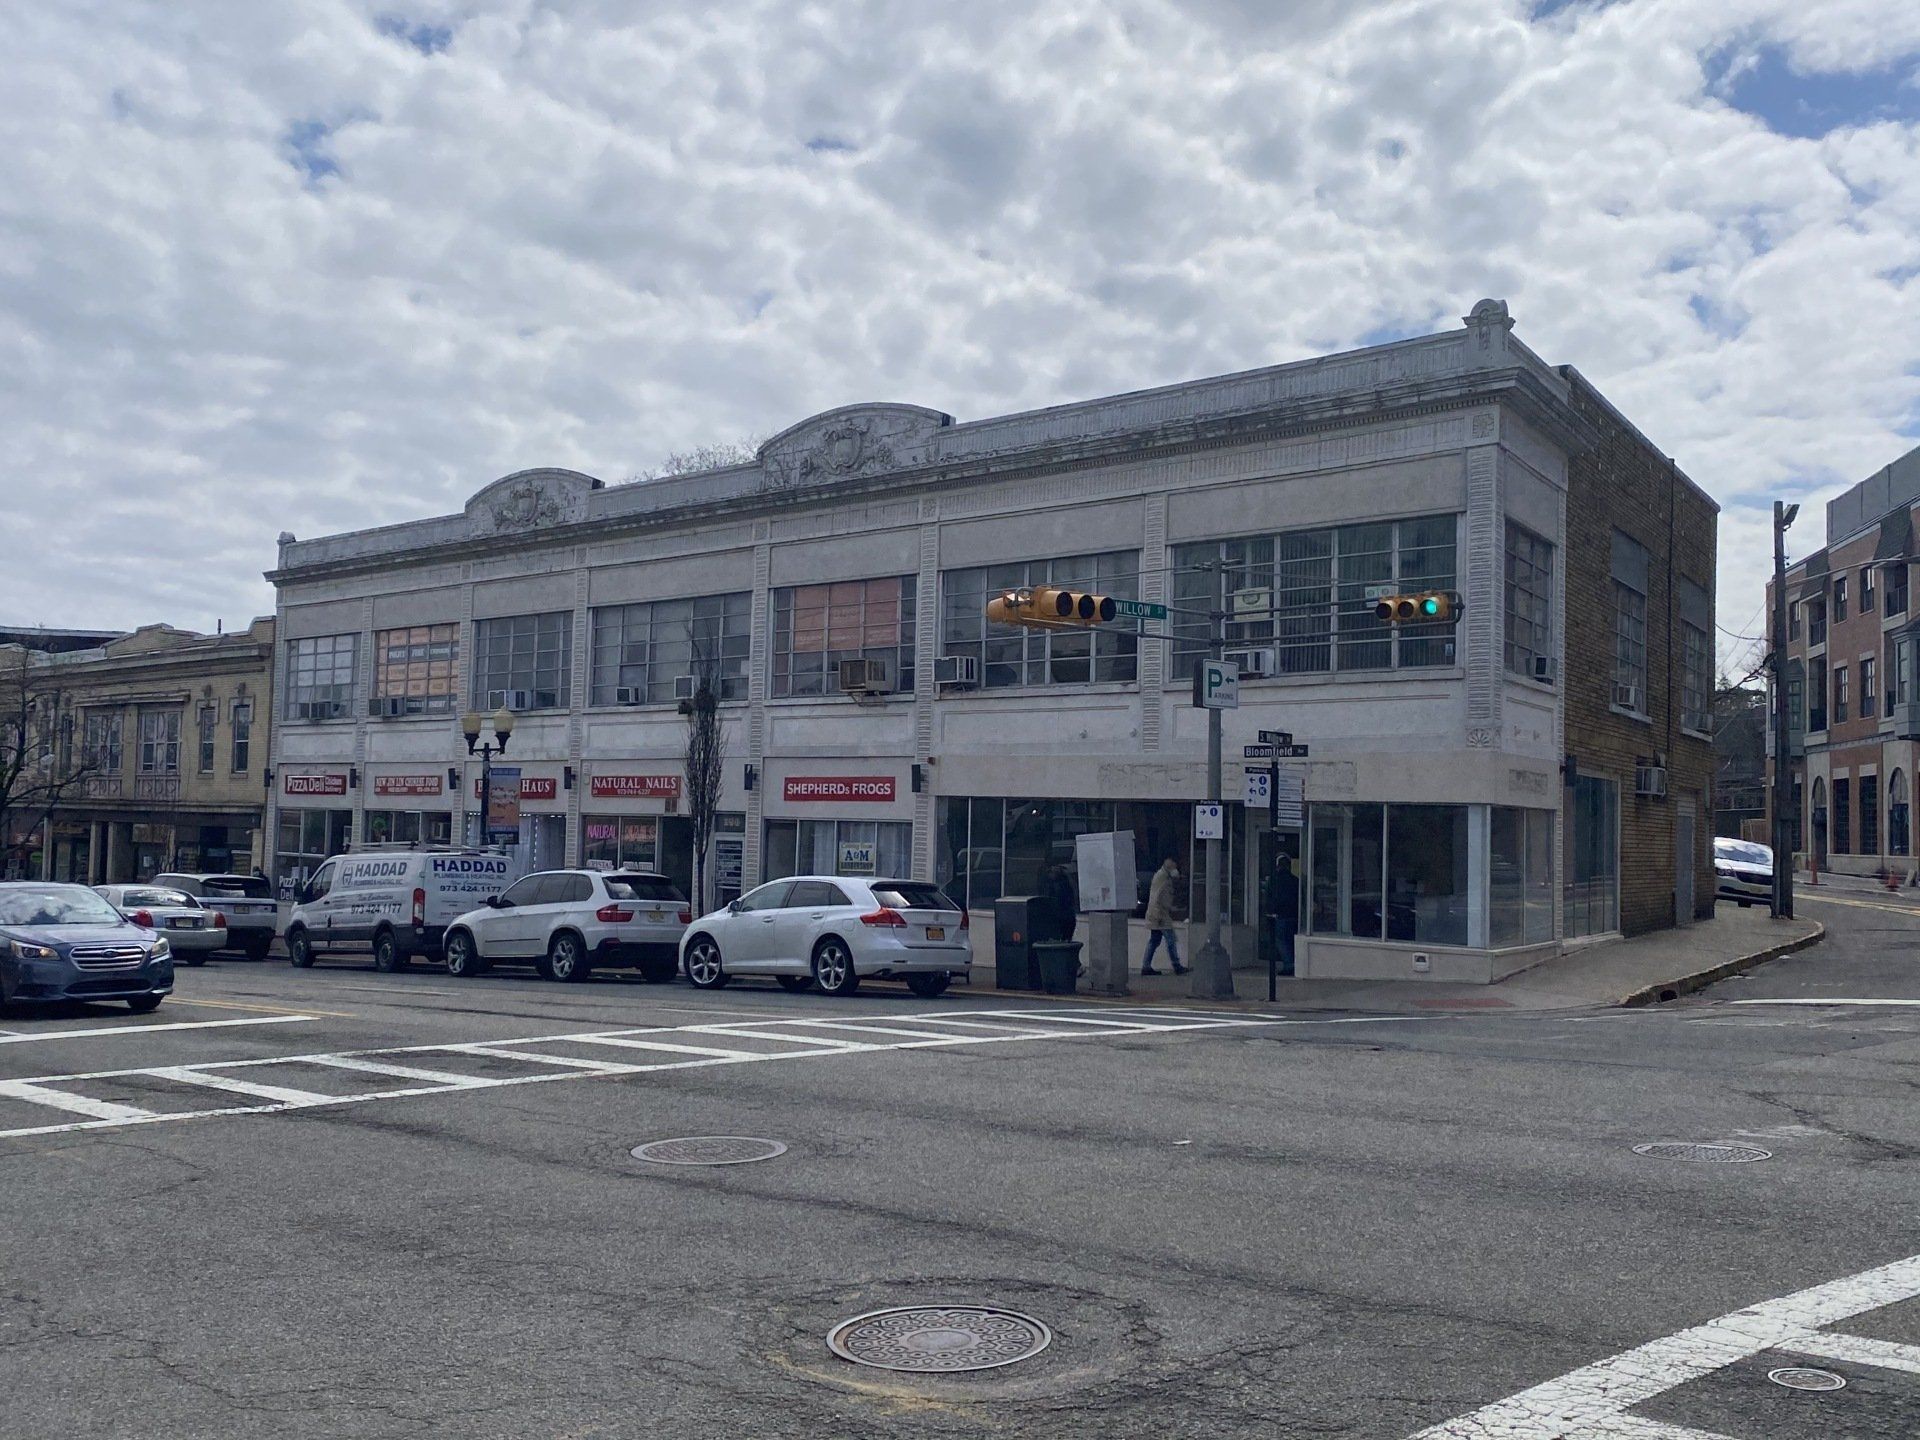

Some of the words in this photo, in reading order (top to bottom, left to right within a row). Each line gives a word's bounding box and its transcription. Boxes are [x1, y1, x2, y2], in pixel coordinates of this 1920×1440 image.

[1115, 601, 1150, 616] WILLOW
[1245, 746, 1293, 757] Bloomfield
[309, 777, 325, 792] Deli
[521, 779, 550, 793] HAUS
[593, 777, 641, 789] NATURAL
[645, 777, 677, 789] NAILS
[852, 783, 892, 795] FROGS
[587, 824, 617, 839] NATURAL
[355, 862, 408, 877] HADDAD
[433, 859, 507, 874] HADDAD
[280, 888, 294, 900] Deli
[460, 885, 502, 893] 424.1177
[351, 904, 365, 914] 973
